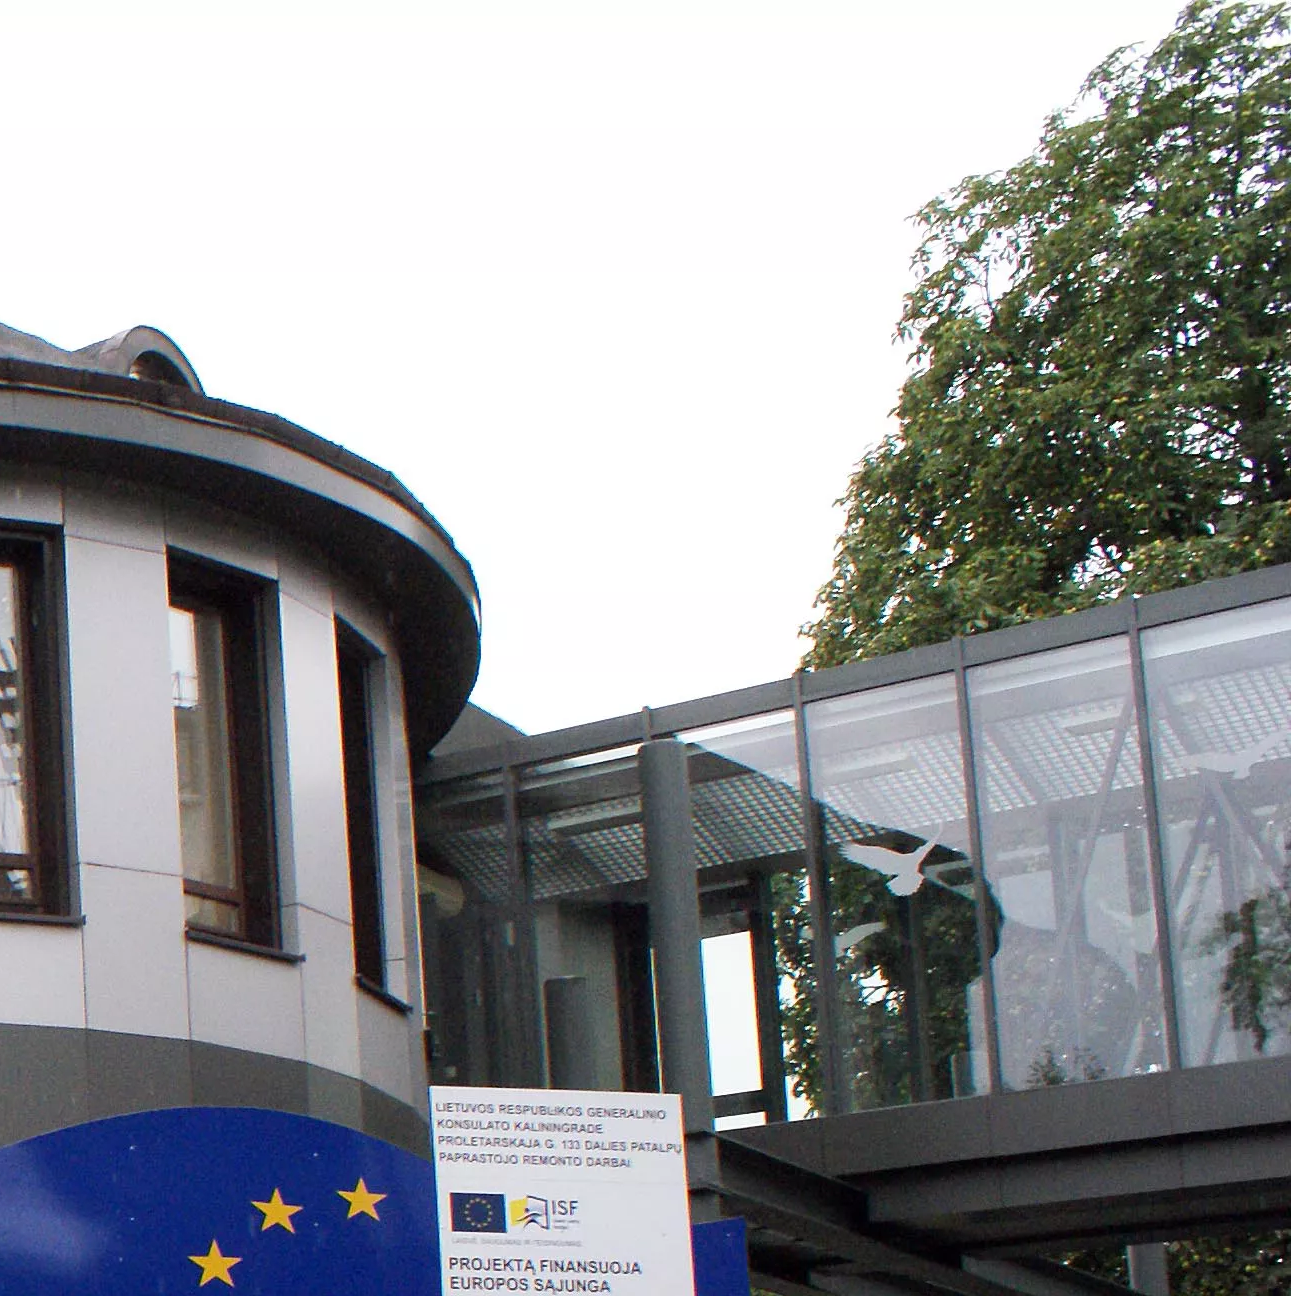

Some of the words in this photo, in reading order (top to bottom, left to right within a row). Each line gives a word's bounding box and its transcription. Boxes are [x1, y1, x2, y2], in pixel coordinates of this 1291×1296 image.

[435, 1102, 494, 1114] LIETUVOS
[498, 1104, 582, 1116] RESPUBLIKOS
[586, 1107, 666, 1120] GENERALINIO
[437, 1119, 510, 1131] KONSULATO
[514, 1121, 604, 1134] KALININGRADE
[438, 1135, 540, 1148] PROLETARSKAJA
[561, 1139, 581, 1150] 133
[584, 1140, 627, 1152] DALIES
[439, 1152, 519, 1165] PAPRASTOJO
[522, 1155, 582, 1167] REMONTO
[585, 1157, 631, 1168] DARBAI
[551, 1200, 578, 1216] ISF
[449, 1257, 536, 1275] PROJEKTĄ
[540, 1259, 643, 1275] FINANSUOJA
[450, 1276, 529, 1292] EUROPOS
[534, 1278, 611, 1295] SĄJUNGA
